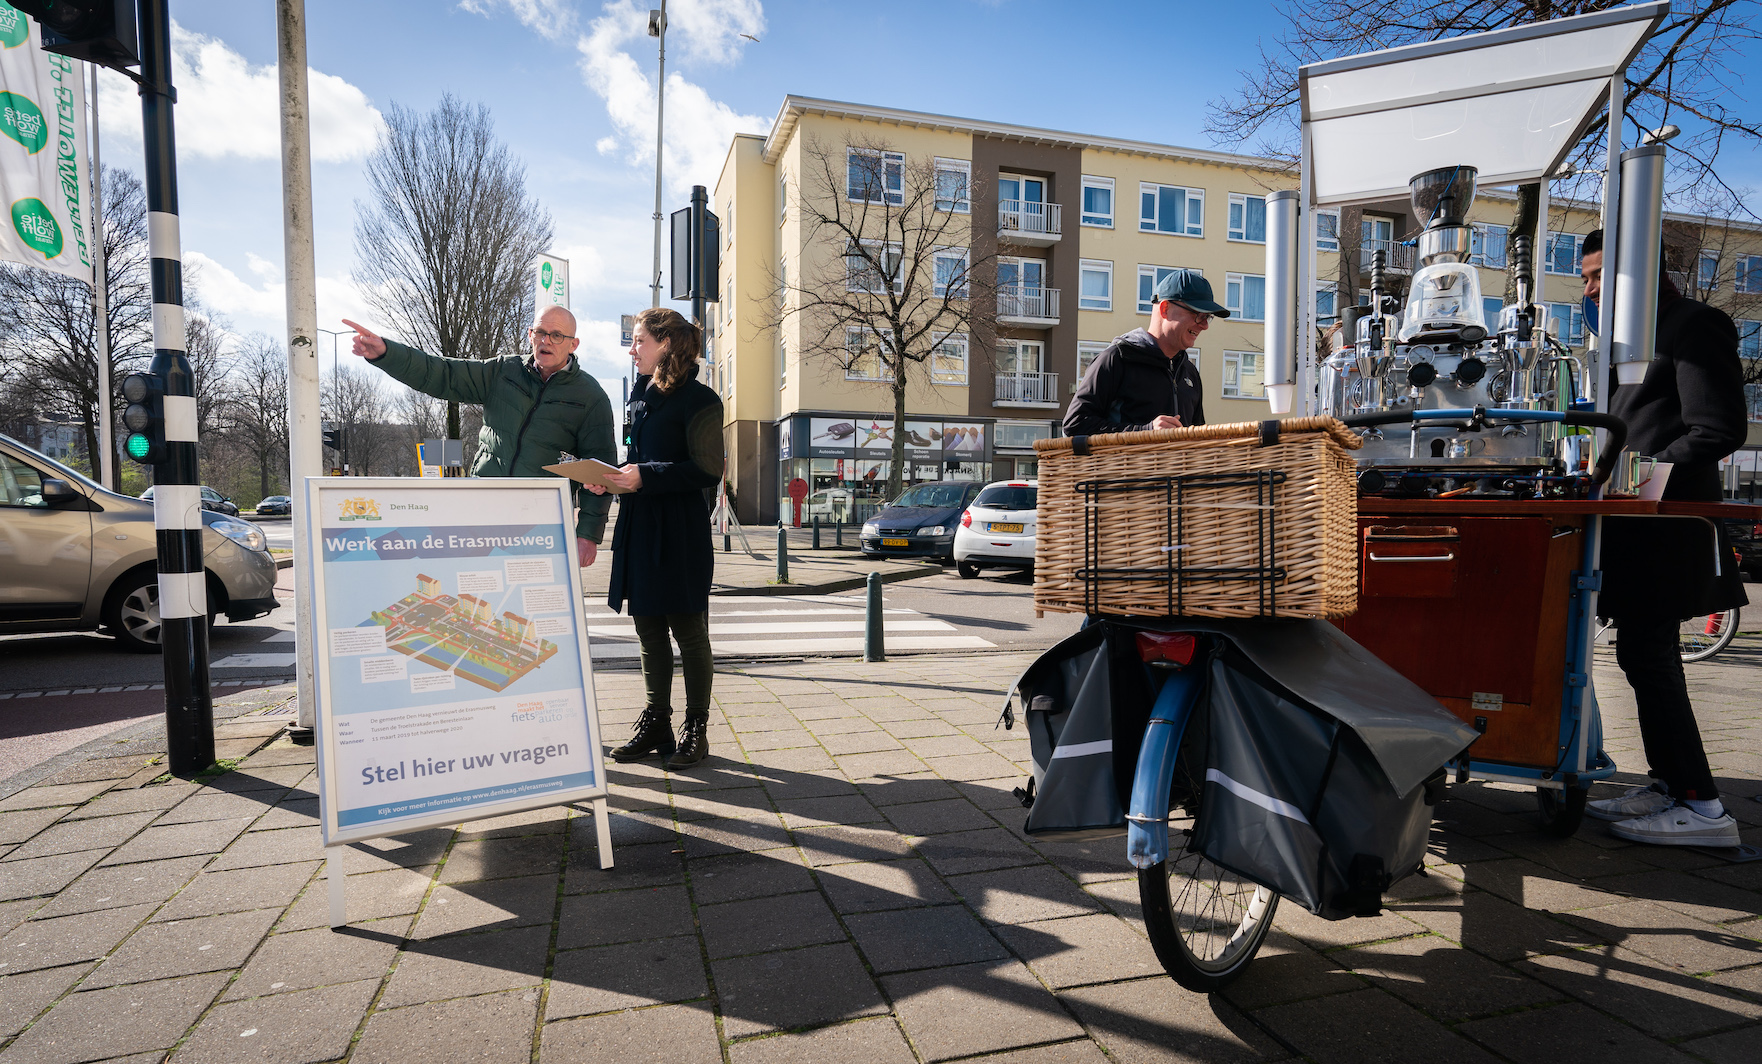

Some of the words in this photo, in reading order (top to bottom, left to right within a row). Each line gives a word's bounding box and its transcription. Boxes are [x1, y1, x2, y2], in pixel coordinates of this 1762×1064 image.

[408, 504, 429, 512] Haag
[325, 536, 378, 552] Werk
[382, 539, 417, 550] aan
[422, 535, 444, 550] de
[448, 535, 554, 549] Erasmusweg
[379, 716, 406, 724] gemeente
[511, 711, 536, 723] fiets
[538, 713, 563, 724] auto
[398, 720, 432, 729] Troelstrakade
[339, 738, 365, 746] Wanneer
[419, 727, 449, 735] halverwege
[361, 761, 406, 786] Stel
[412, 757, 455, 778] hier
[462, 753, 495, 771] uw
[499, 742, 569, 765] vragen
[377, 807, 392, 816] Kijk
[409, 802, 426, 810] meer
[427, 796, 462, 807] informatie
[471, 780, 563, 799] www.denhaag.nl/erasmusweg
